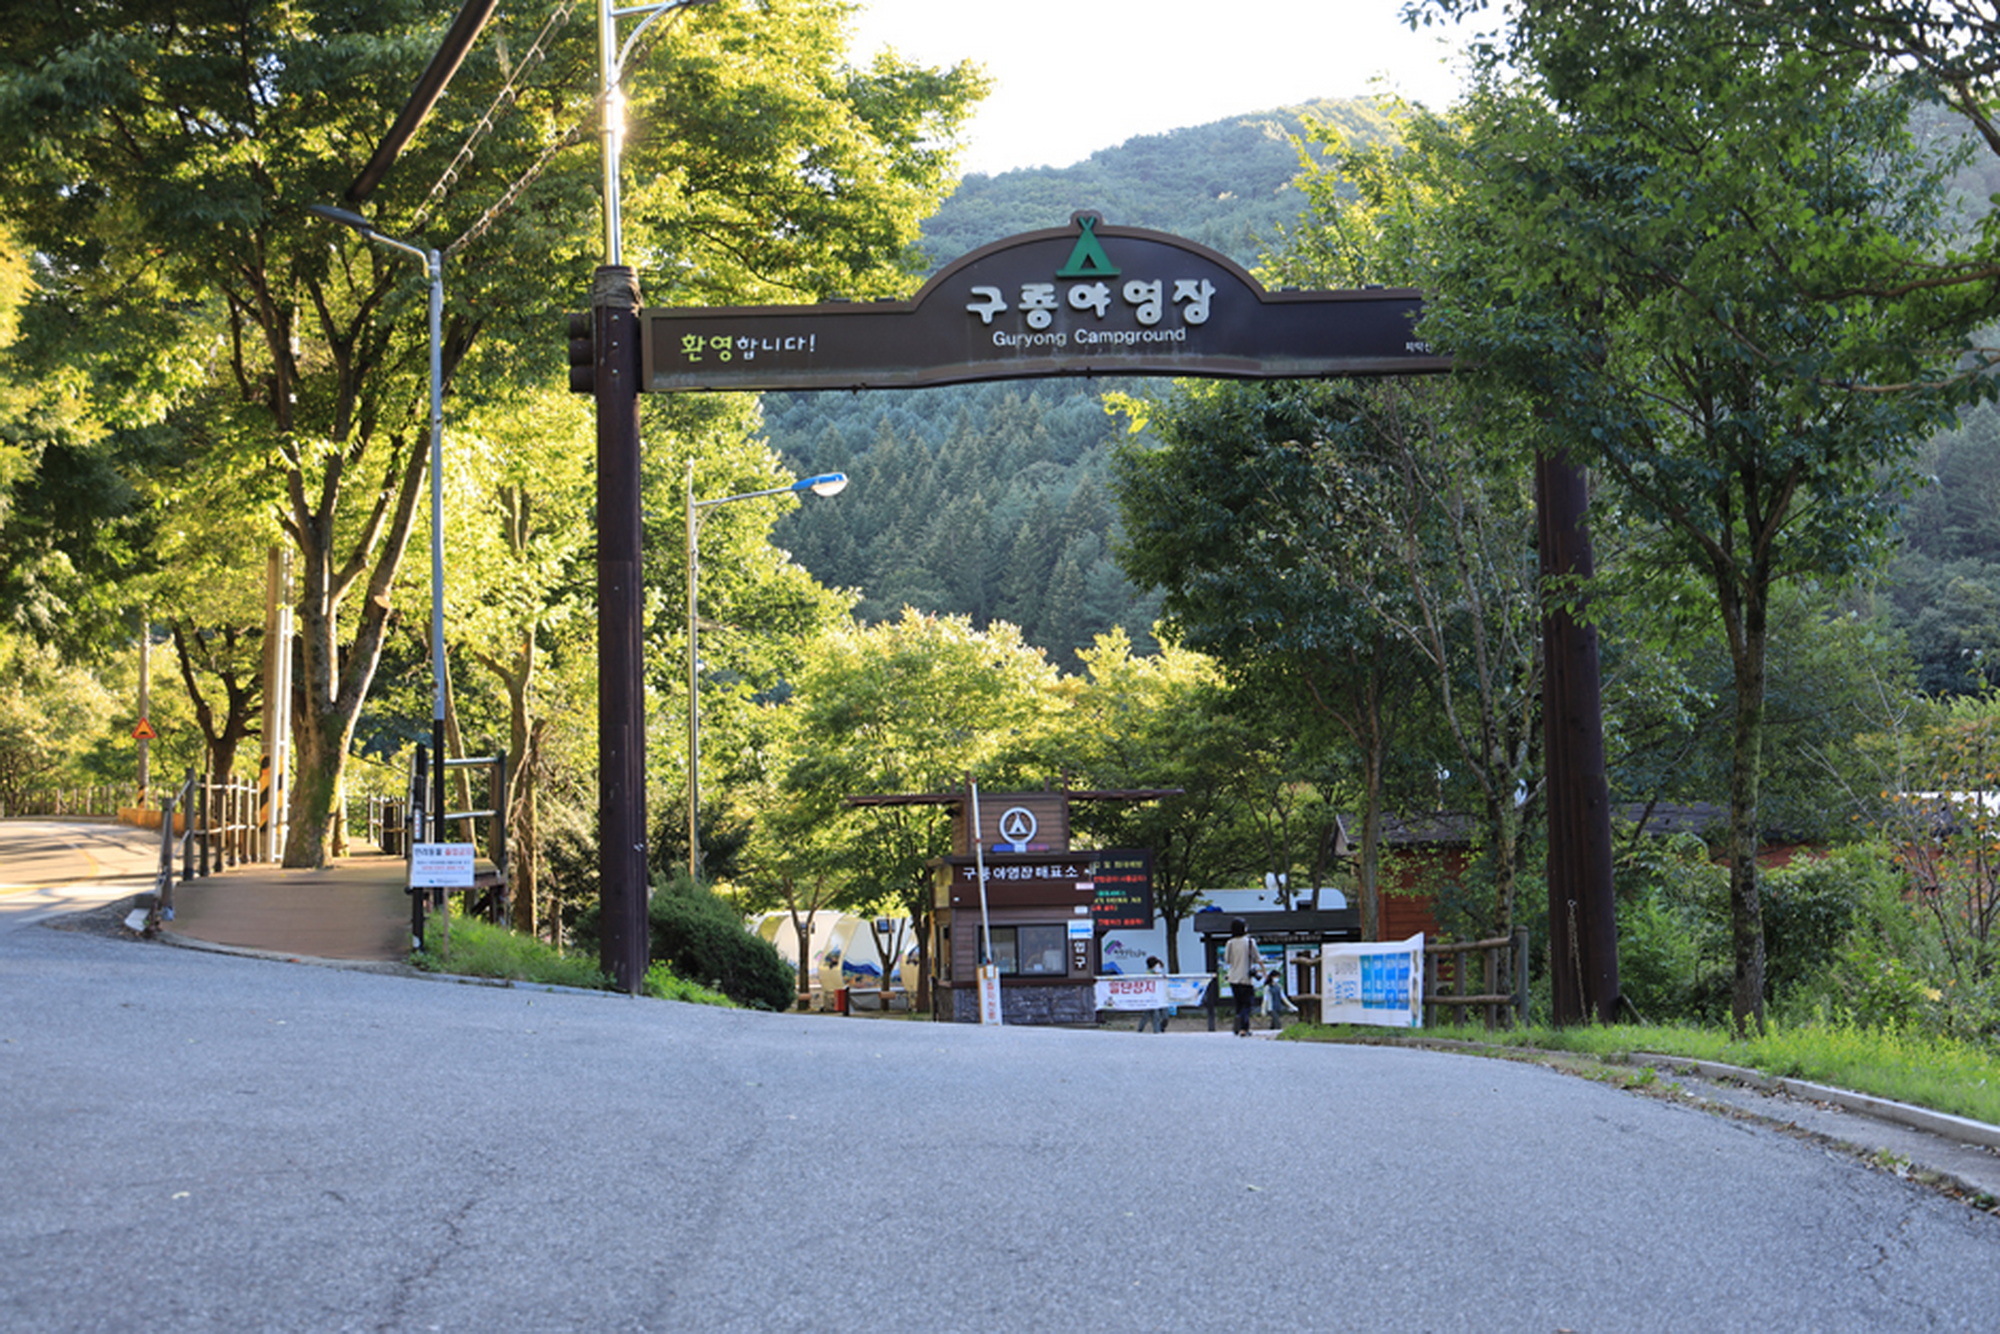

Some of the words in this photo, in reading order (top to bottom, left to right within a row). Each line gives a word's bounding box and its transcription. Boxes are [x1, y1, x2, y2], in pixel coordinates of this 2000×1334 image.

[966, 279, 1216, 330] 구룡야영장
[681, 333, 816, 362] 환영합니다!
[992, 330, 1067, 347] Guryong
[1074, 327, 1187, 345] Campground
